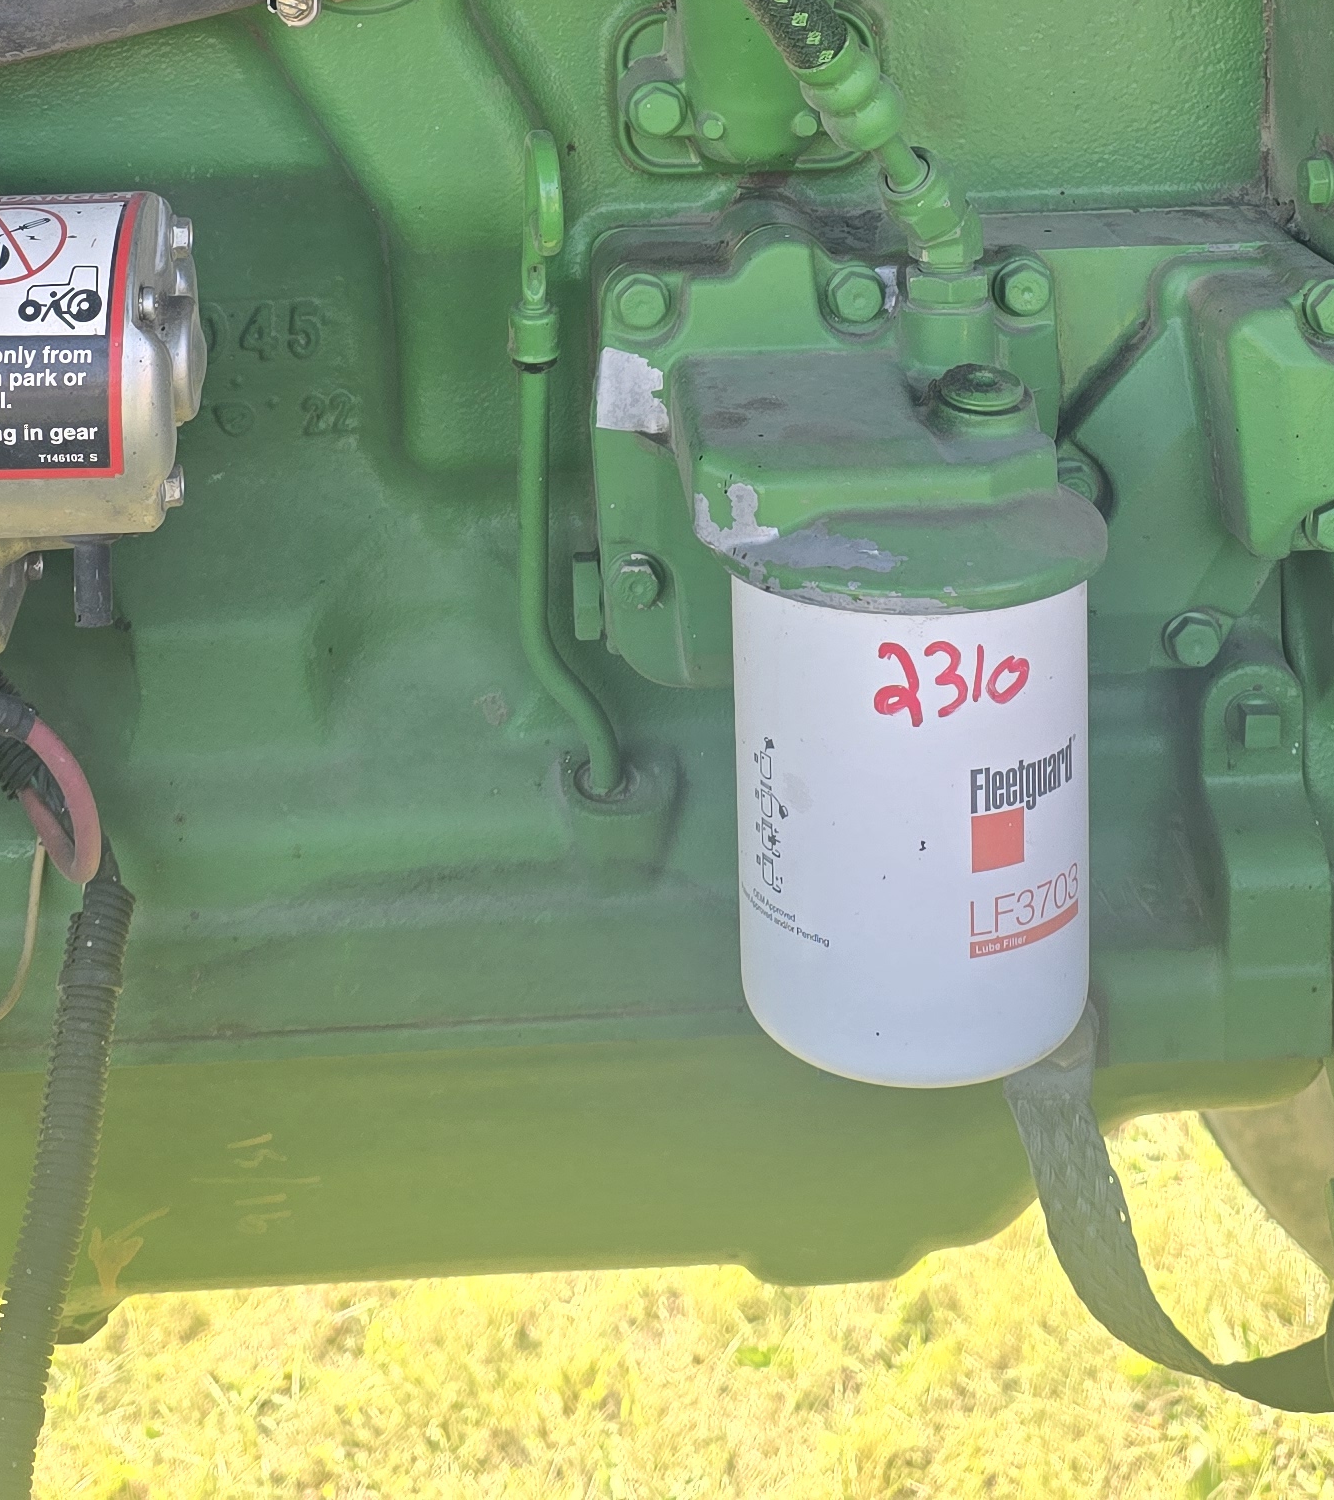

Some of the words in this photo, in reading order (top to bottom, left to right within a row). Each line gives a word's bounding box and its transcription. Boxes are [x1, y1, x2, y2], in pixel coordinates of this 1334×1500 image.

[41, 345, 93, 366] from
[9, 368, 58, 395] park
[63, 372, 87, 388] or
[23, 424, 44, 442] in
[50, 426, 99, 447] gear
[89, 453, 99, 463] S
[873, 640, 1031, 728] 2310
[970, 734, 1075, 815] Fleetguard
[765, 898, 796, 923] Approved
[969, 862, 1079, 938] LF3703
[796, 926, 830, 948] Pending
[975, 941, 1001, 955] Lube
[1003, 934, 1027, 949] Filter
